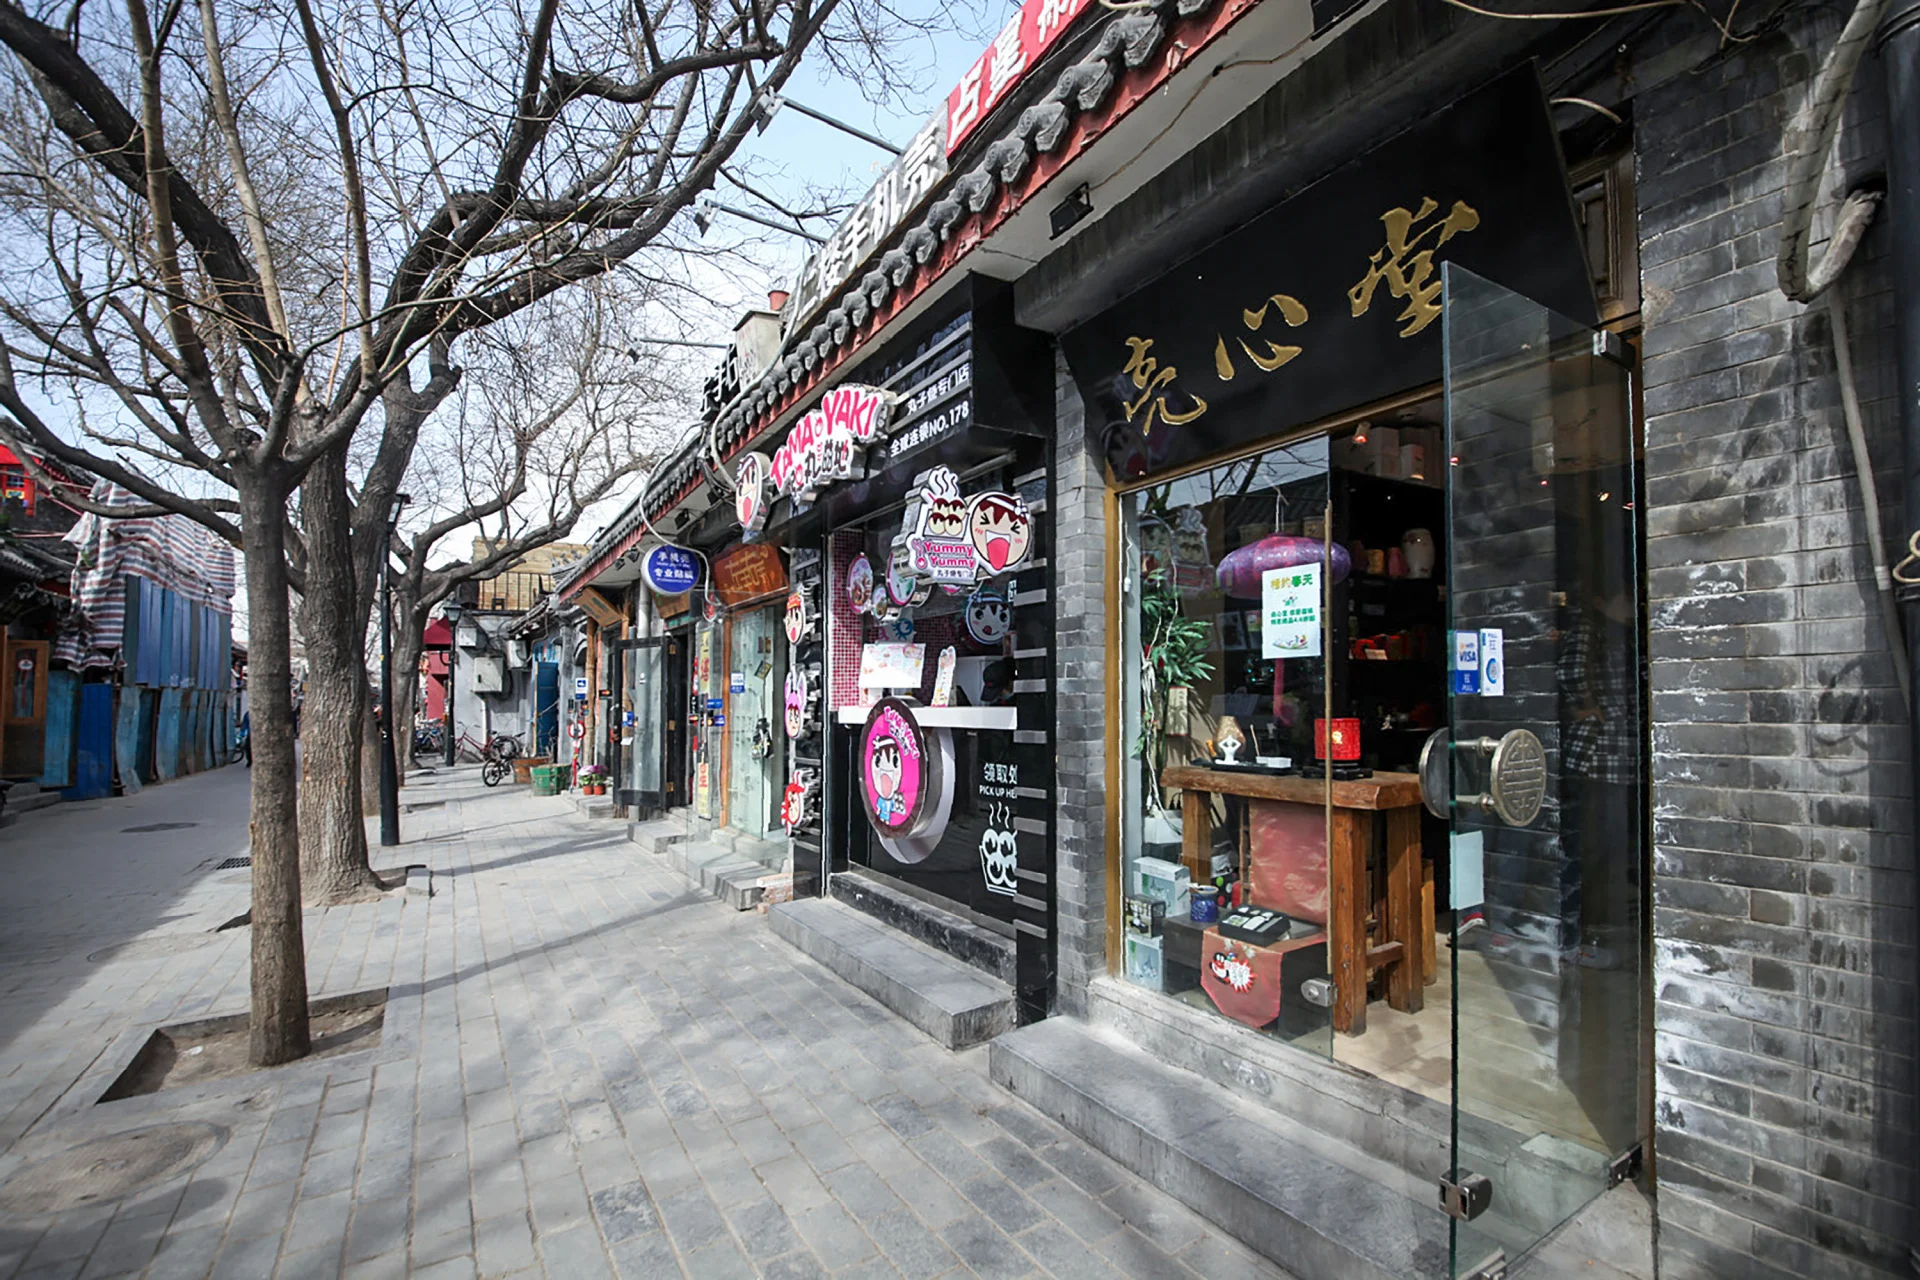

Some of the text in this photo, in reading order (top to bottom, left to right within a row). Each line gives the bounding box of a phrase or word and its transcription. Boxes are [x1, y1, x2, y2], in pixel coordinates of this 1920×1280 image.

[770, 390, 878, 489] TAMA YAKI
[924, 541, 973, 557] Yummy
[930, 556, 974, 569] Yummy
[1460, 651, 1476, 662] VISA
[995, 787, 1005, 797] UP
